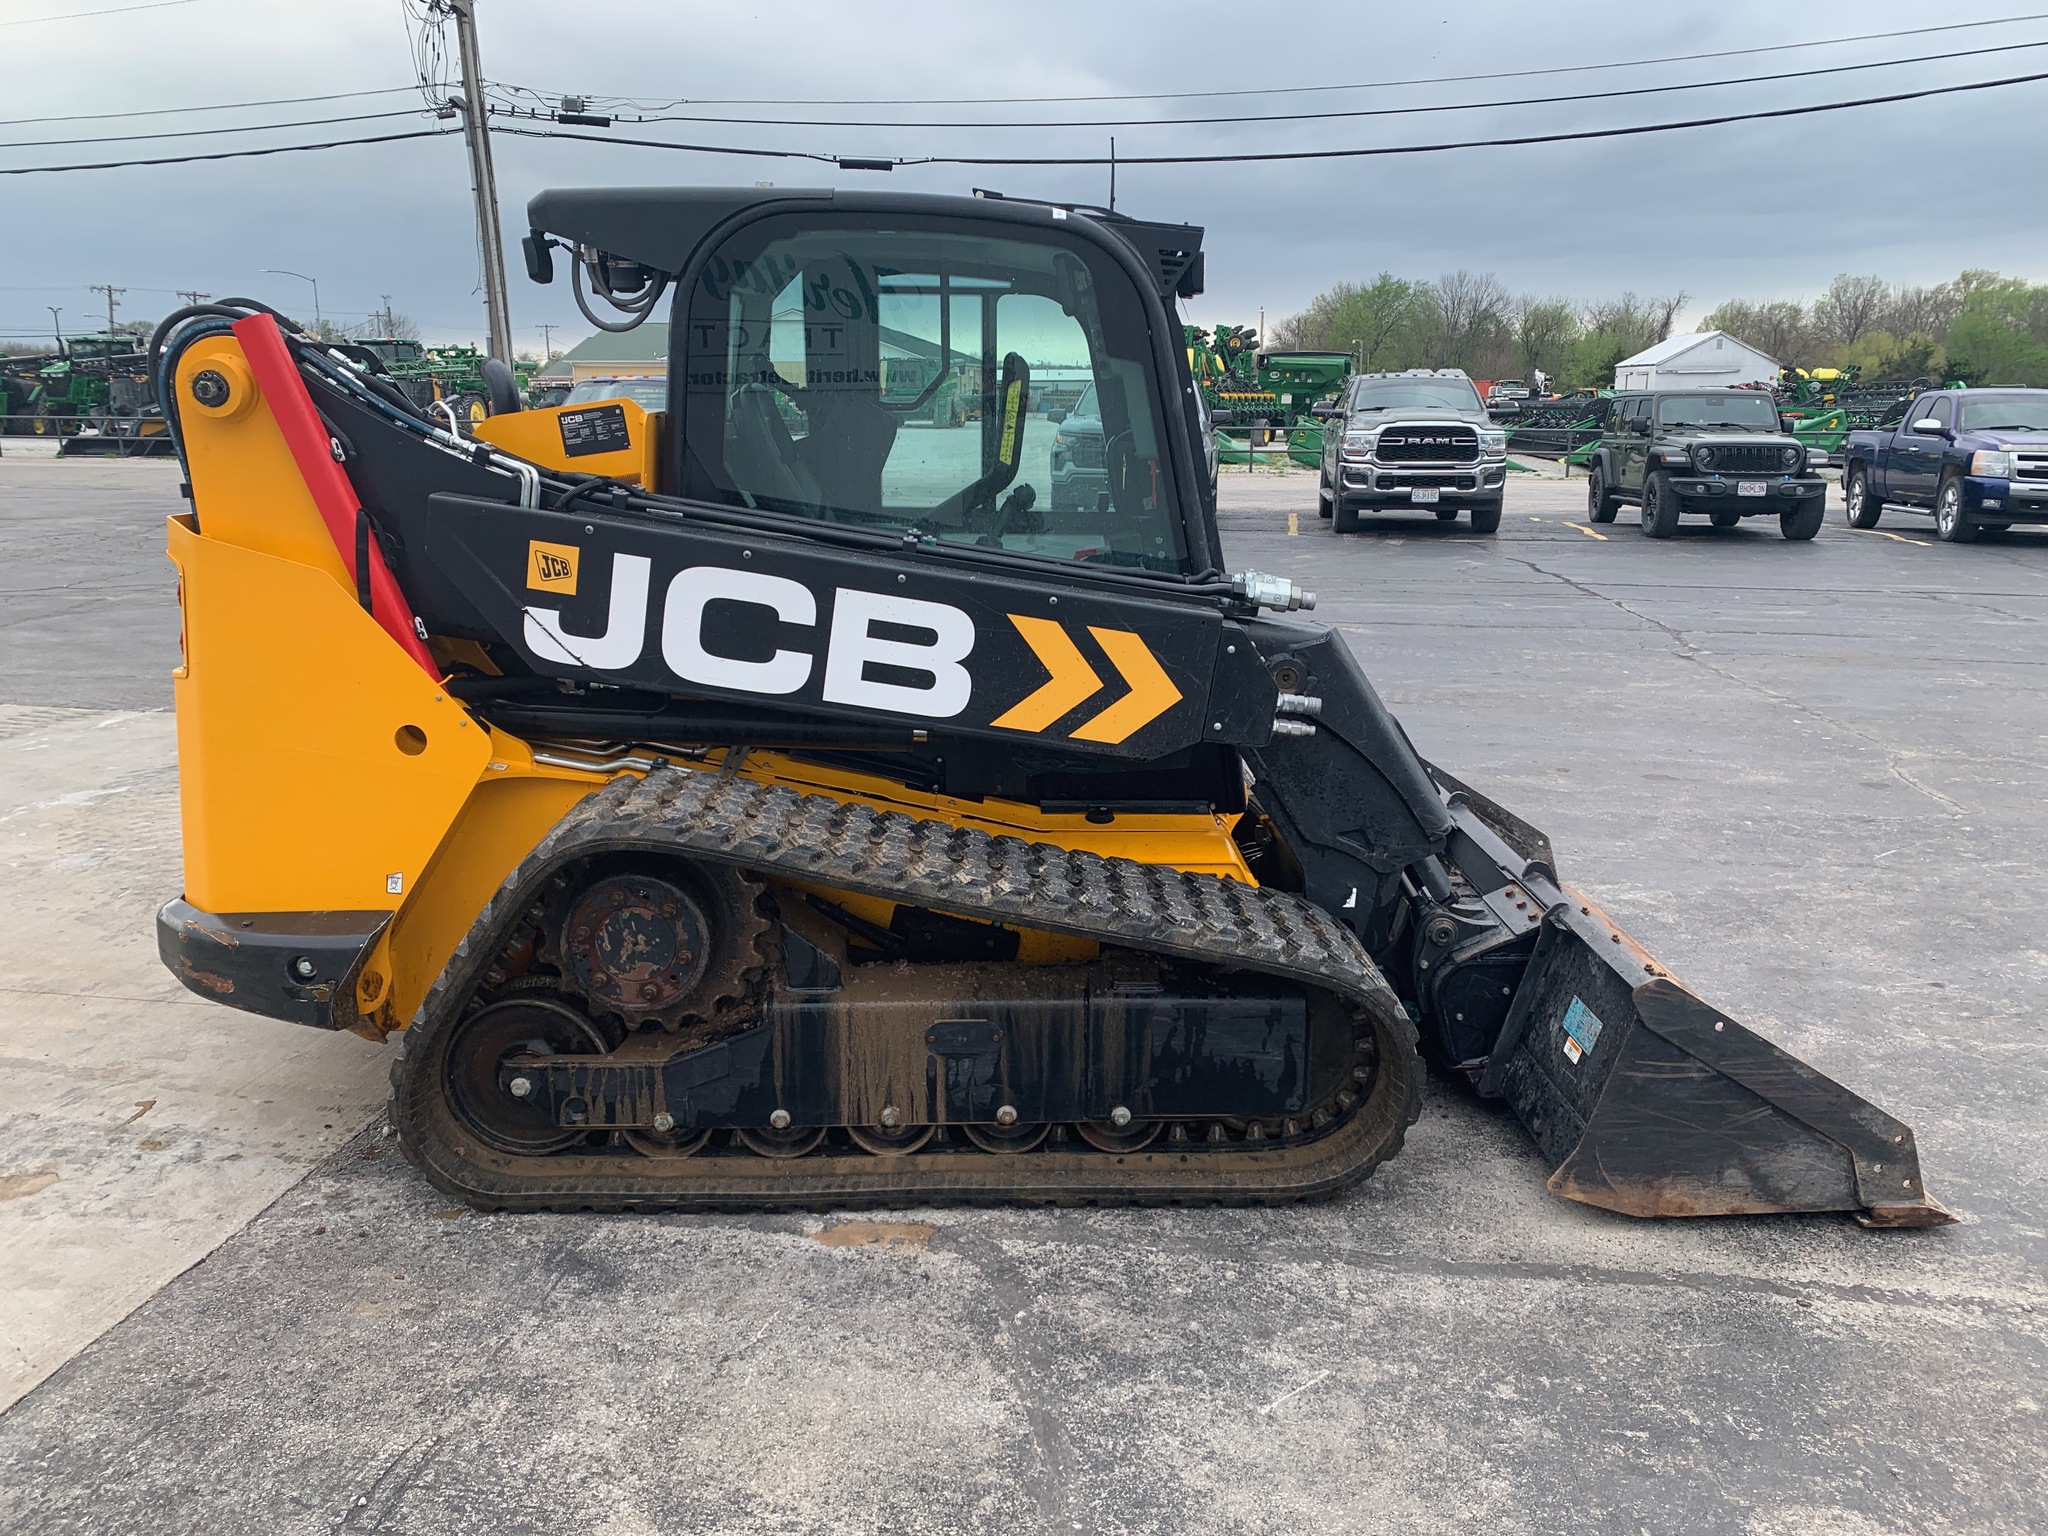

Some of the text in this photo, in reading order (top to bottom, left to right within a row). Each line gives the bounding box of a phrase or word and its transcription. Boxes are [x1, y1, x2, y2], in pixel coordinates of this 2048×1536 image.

[561, 414, 584, 425] JCB
[1830, 419, 1838, 428] 2
[541, 554, 570, 579] JCB
[523, 552, 976, 718] JCB
